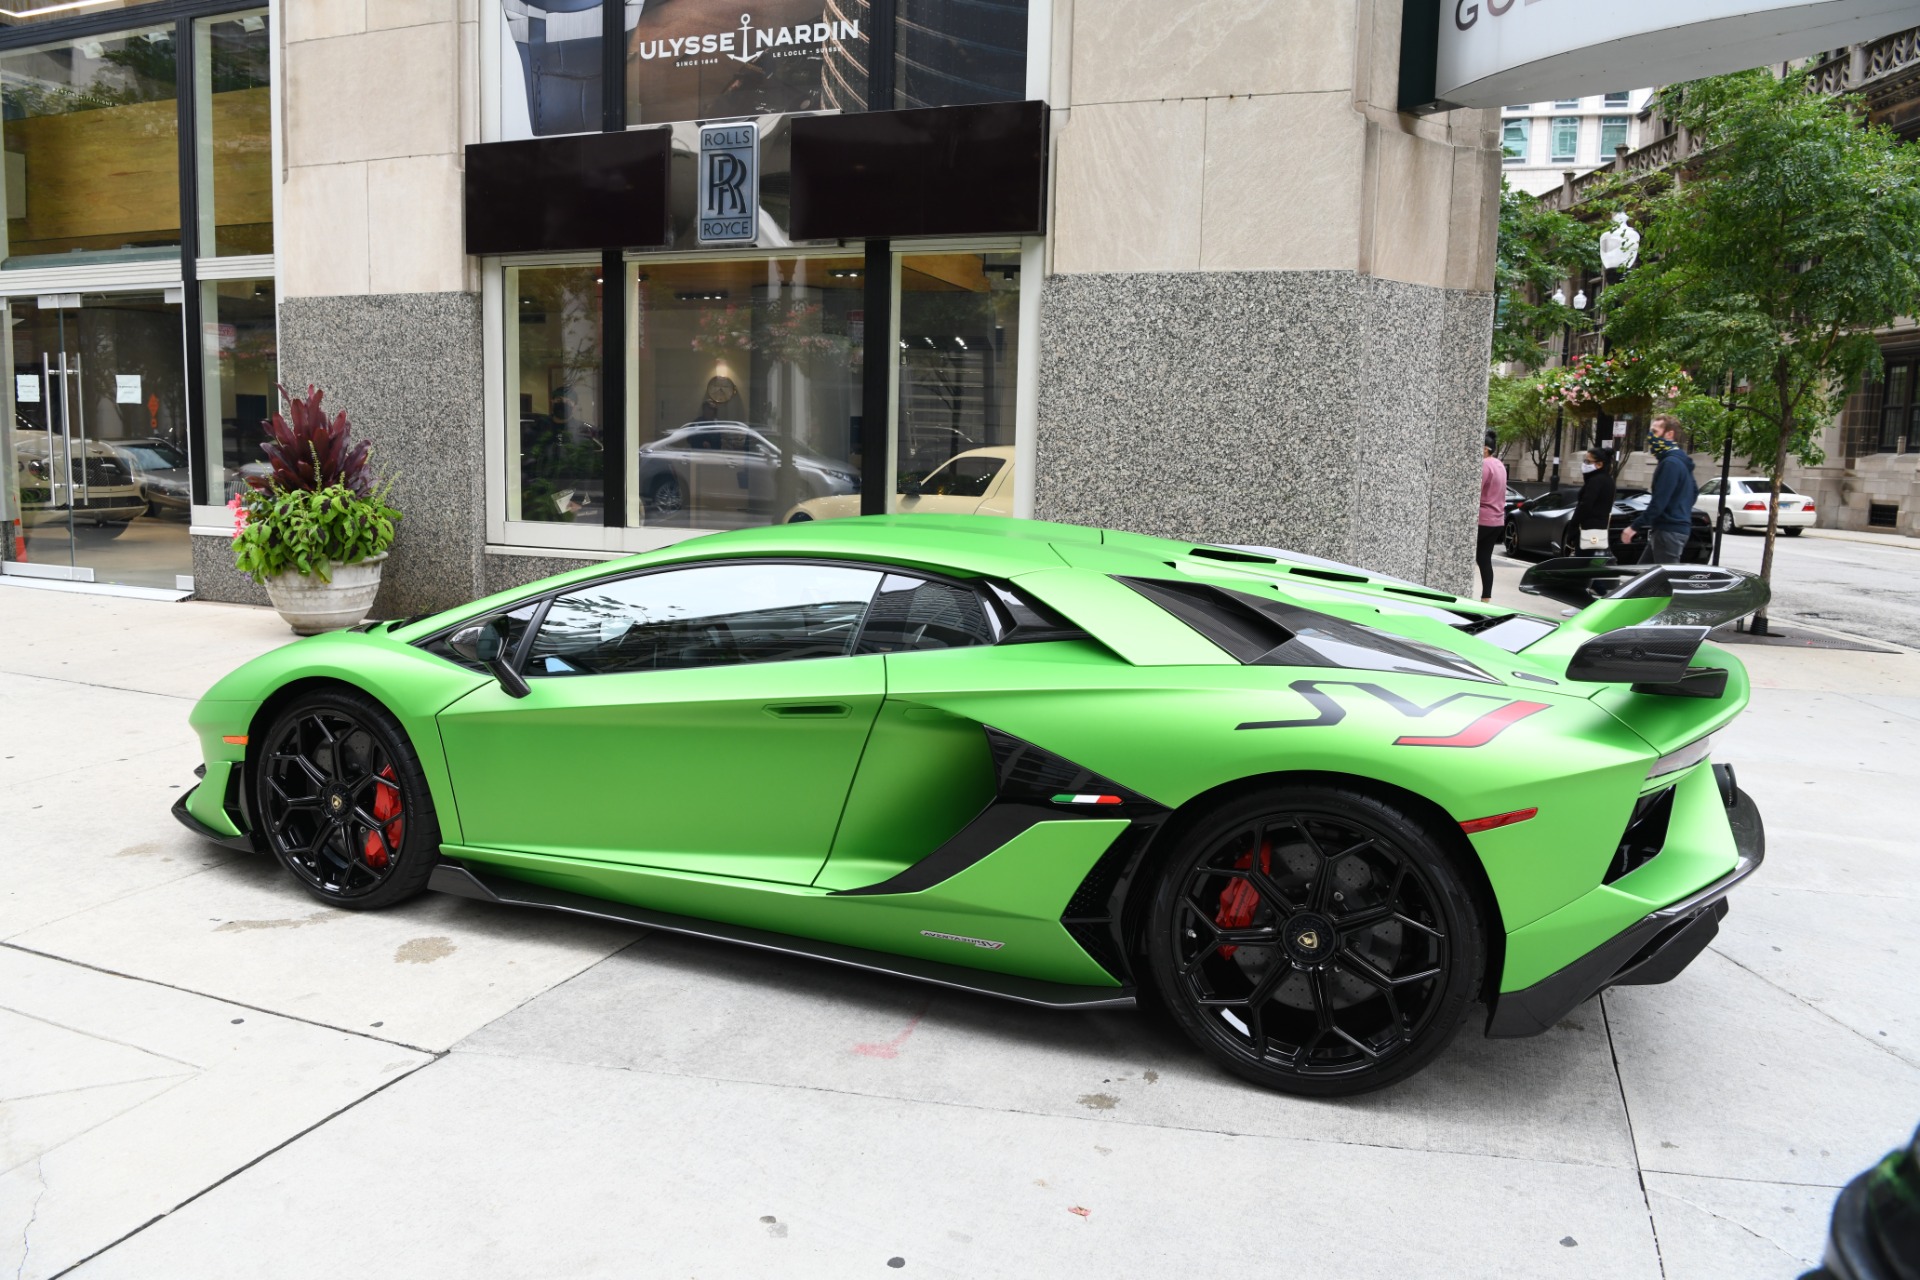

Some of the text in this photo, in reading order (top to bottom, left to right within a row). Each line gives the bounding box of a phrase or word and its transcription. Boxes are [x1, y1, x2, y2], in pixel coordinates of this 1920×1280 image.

[640, 19, 859, 60] ULYSSE NARDIN
[704, 130, 750, 146] ROLLS
[703, 221, 749, 236] ROYCE
